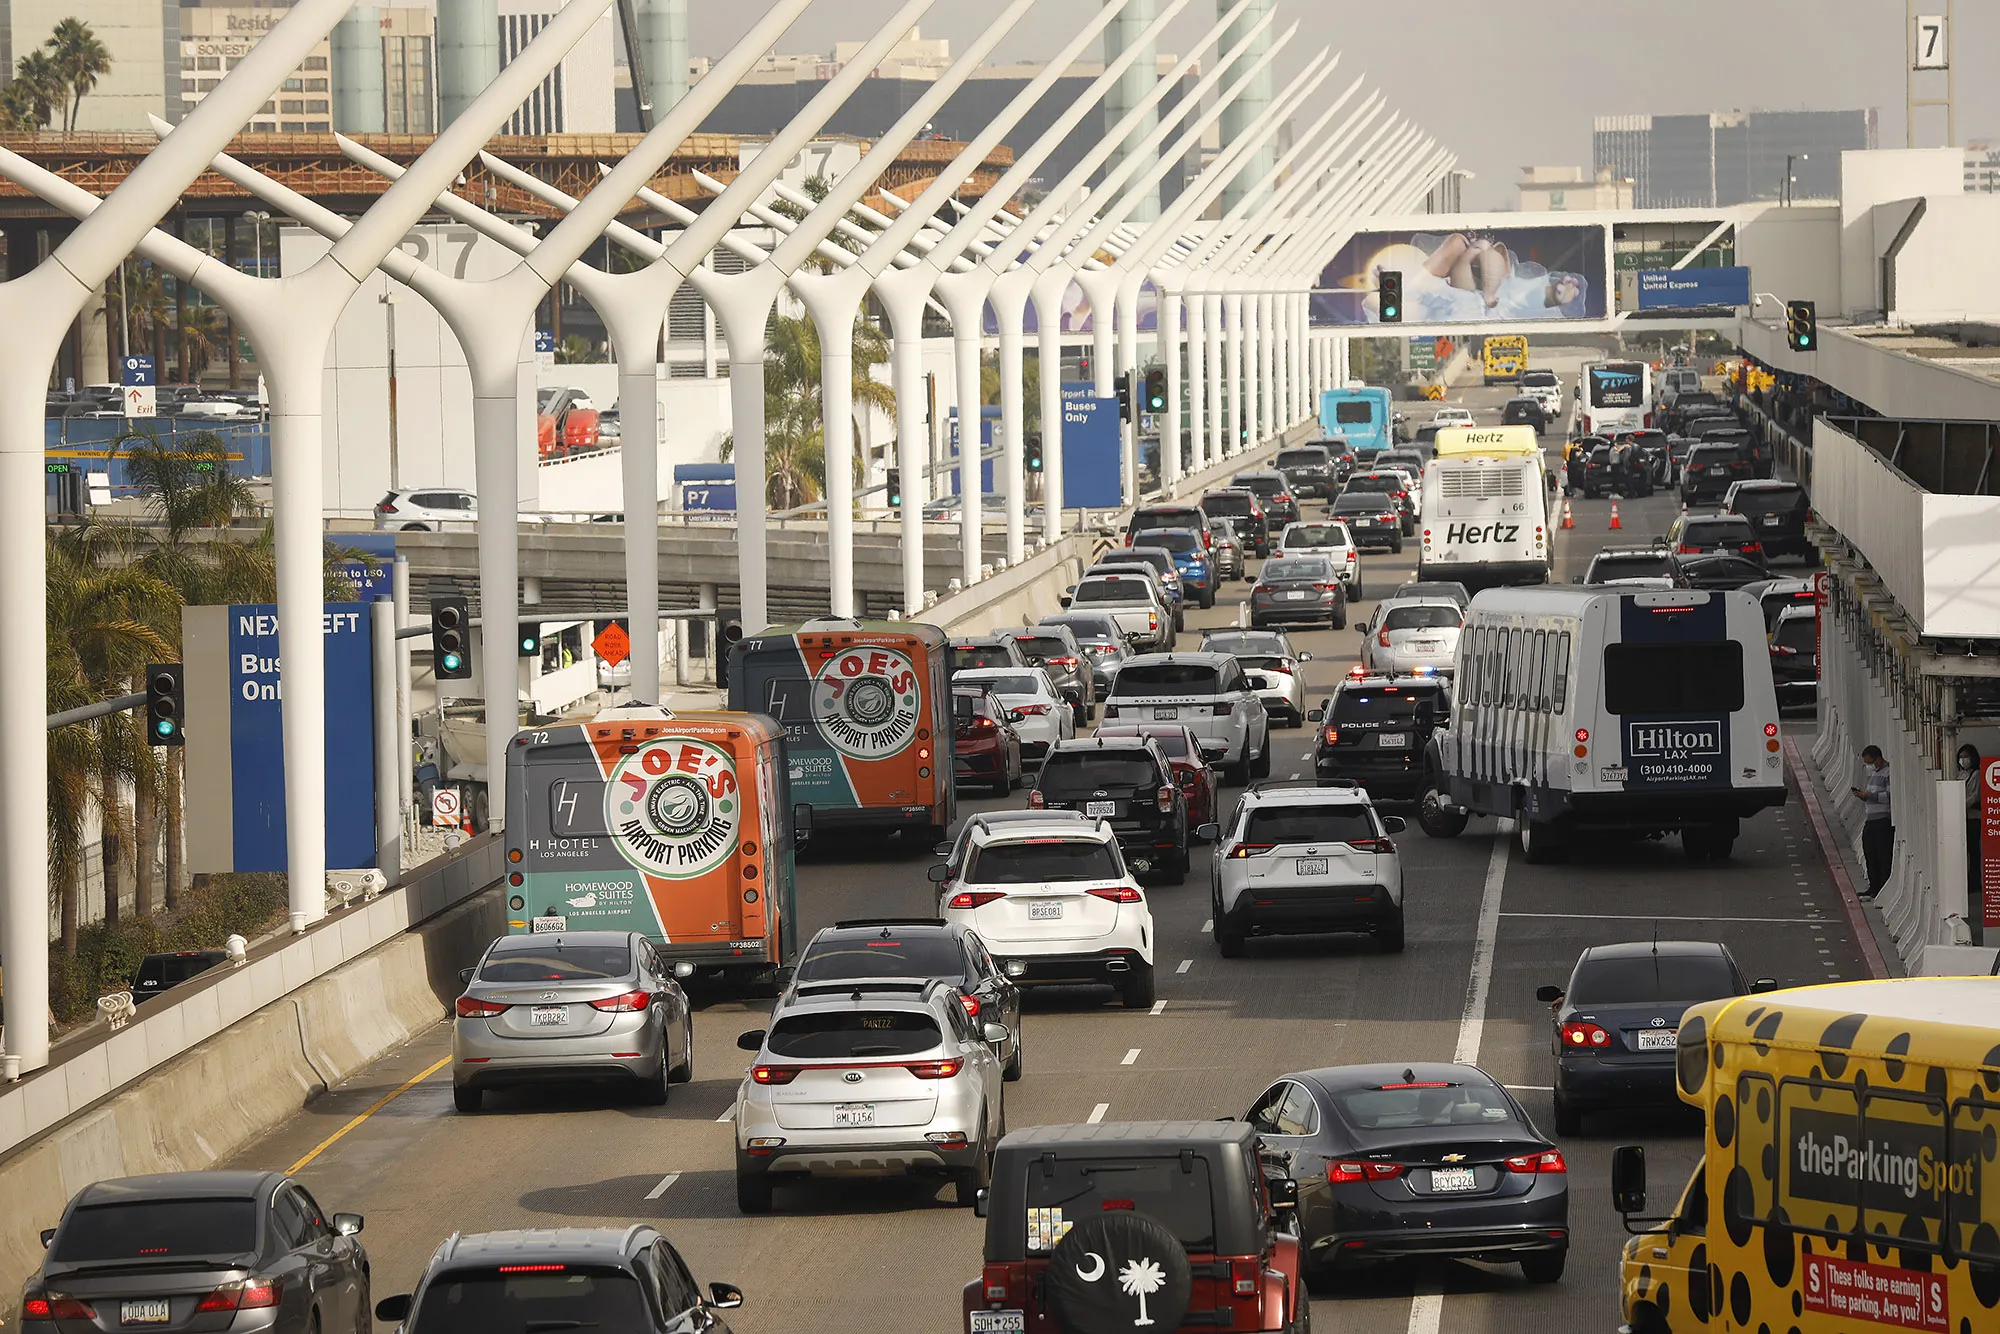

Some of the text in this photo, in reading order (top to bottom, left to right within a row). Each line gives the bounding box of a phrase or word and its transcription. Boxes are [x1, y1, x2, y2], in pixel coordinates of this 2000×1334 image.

[227, 15, 281, 30] Reside
[1923, 25, 1939, 58] 7
[198, 44, 252, 56] SONEST
[447, 233, 478, 279] 7
[1626, 276, 1633, 287] 7
[1643, 274, 1667, 283] United
[1643, 281, 1699, 290] United Express
[1062, 388, 1085, 398] irport
[136, 405, 153, 414] Exit
[1065, 401, 1097, 411] Buses
[1065, 412, 1088, 424] Only
[1466, 432, 1504, 443] Hertz
[47, 464, 69, 473] OPEN
[687, 489, 710, 505] P7
[1512, 503, 1524, 512] 66
[1446, 521, 1520, 544] Hertz
[351, 569, 361, 578] to
[365, 579, 373, 587] &
[239, 612, 360, 636] NEX EFT
[749, 640, 763, 650] 77
[241, 654, 281, 674] Bus
[823, 651, 914, 699] JOE'S
[242, 680, 282, 701] Onl
[661, 727, 727, 735] JoesAirportParking.com
[786, 725, 809, 735] TEL
[823, 709, 914, 749] AIRPORT PARKING
[532, 732, 549, 745] 72
[1637, 728, 1714, 750] Hilton
[1664, 750, 1688, 759] LAX
[788, 757, 832, 766] OMEWOOD
[620, 744, 737, 802] JOE'S
[805, 765, 832, 773] SUITES
[685, 781, 696, 791] ALL
[695, 788, 704, 801] THE
[650, 778, 681, 817] ALWAYS ELECTRIC
[657, 820, 699, 834] GREEN MACHINE
[529, 838, 599, 850] H HOTEL
[620, 816, 733, 866] AIRPORT PARKING
[565, 881, 633, 892] HOMEWOOD
[598, 890, 634, 900] SUITES
[1641, 1036, 1676, 1047] 7RWX252
[847, 1073, 862, 1081] KIA
[836, 1112, 873, 1124] 8MLT156
[1798, 1131, 1975, 1202] theParkingSpot
[1434, 1175, 1474, 1188] 8CYC326
[1809, 1262, 1820, 1293] S
[1828, 1263, 1921, 1302] These folks are earning
[1930, 1282, 1942, 1313] S
[1830, 1288, 1921, 1324] free parking. Are you?
[1002, 1317, 1020, 1330] 255
